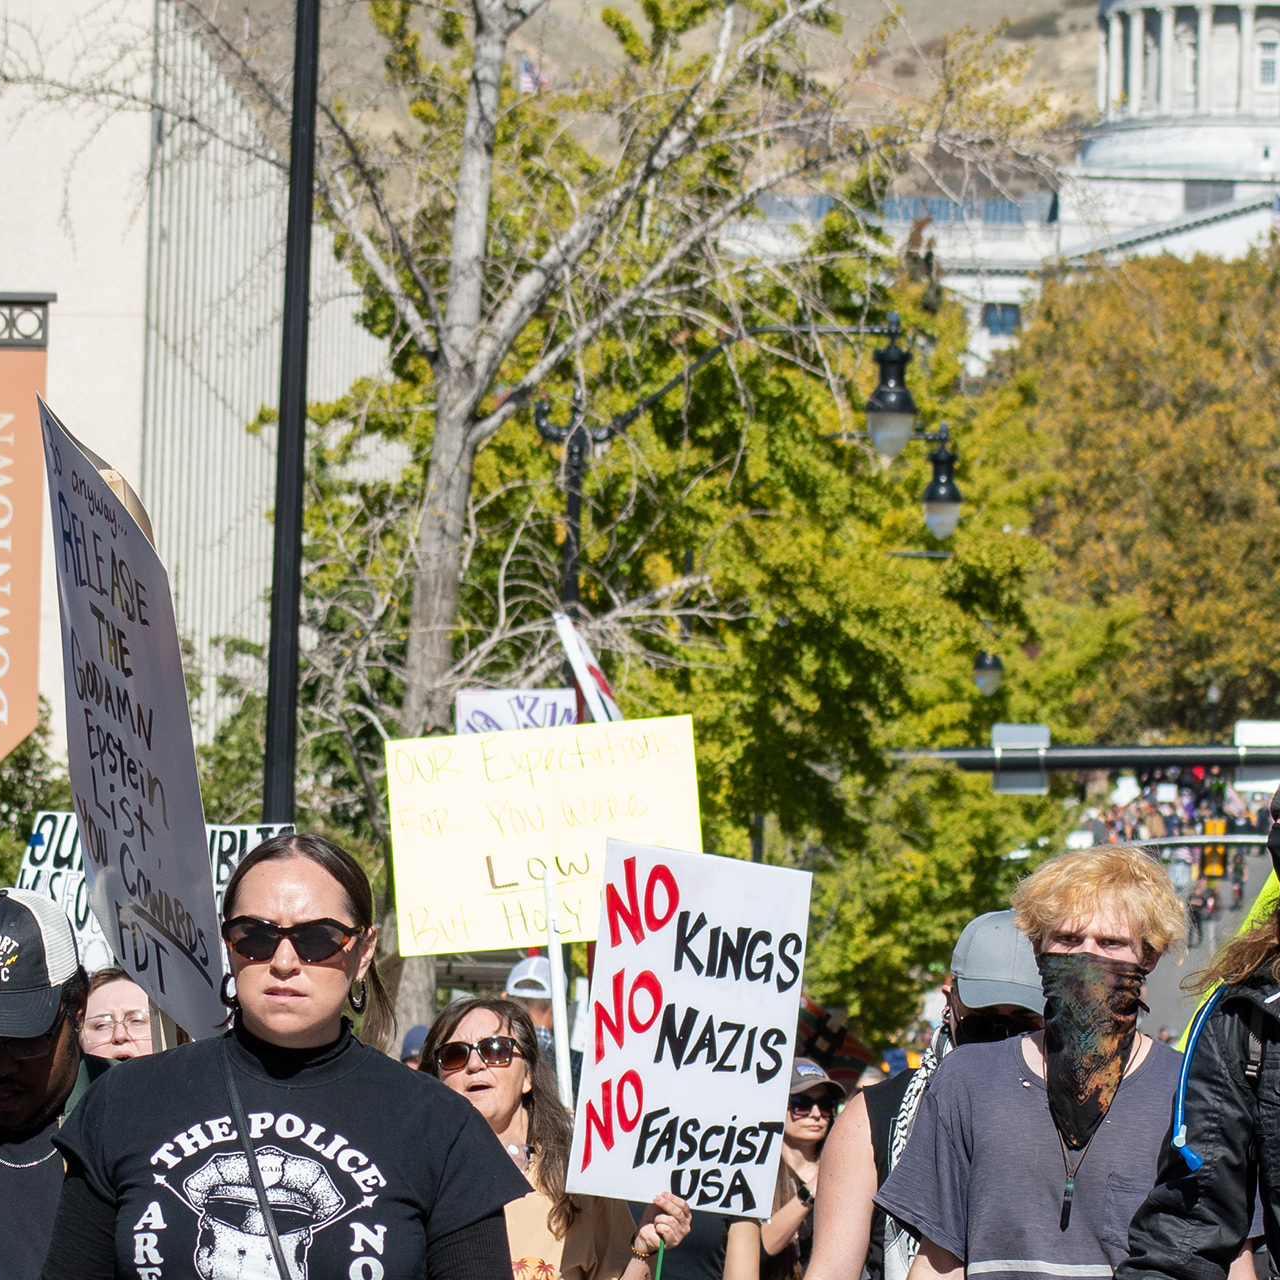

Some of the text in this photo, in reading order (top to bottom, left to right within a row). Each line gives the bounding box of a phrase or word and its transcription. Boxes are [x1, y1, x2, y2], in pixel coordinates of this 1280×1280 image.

[57, 490, 151, 628] RELEASE
[88, 600, 134, 678] THE
[71, 626, 154, 751] GODAMN
[394, 745, 461, 785] OUR
[28, 814, 84, 871] OU
[114, 900, 171, 996] FDT
[605, 856, 803, 994] NO KINGS
[594, 966, 788, 1084] NO NAZIS
[149, 1112, 388, 1193] THE POLICE
[580, 1069, 644, 1174] NO
[670, 1168, 757, 1213] USA
